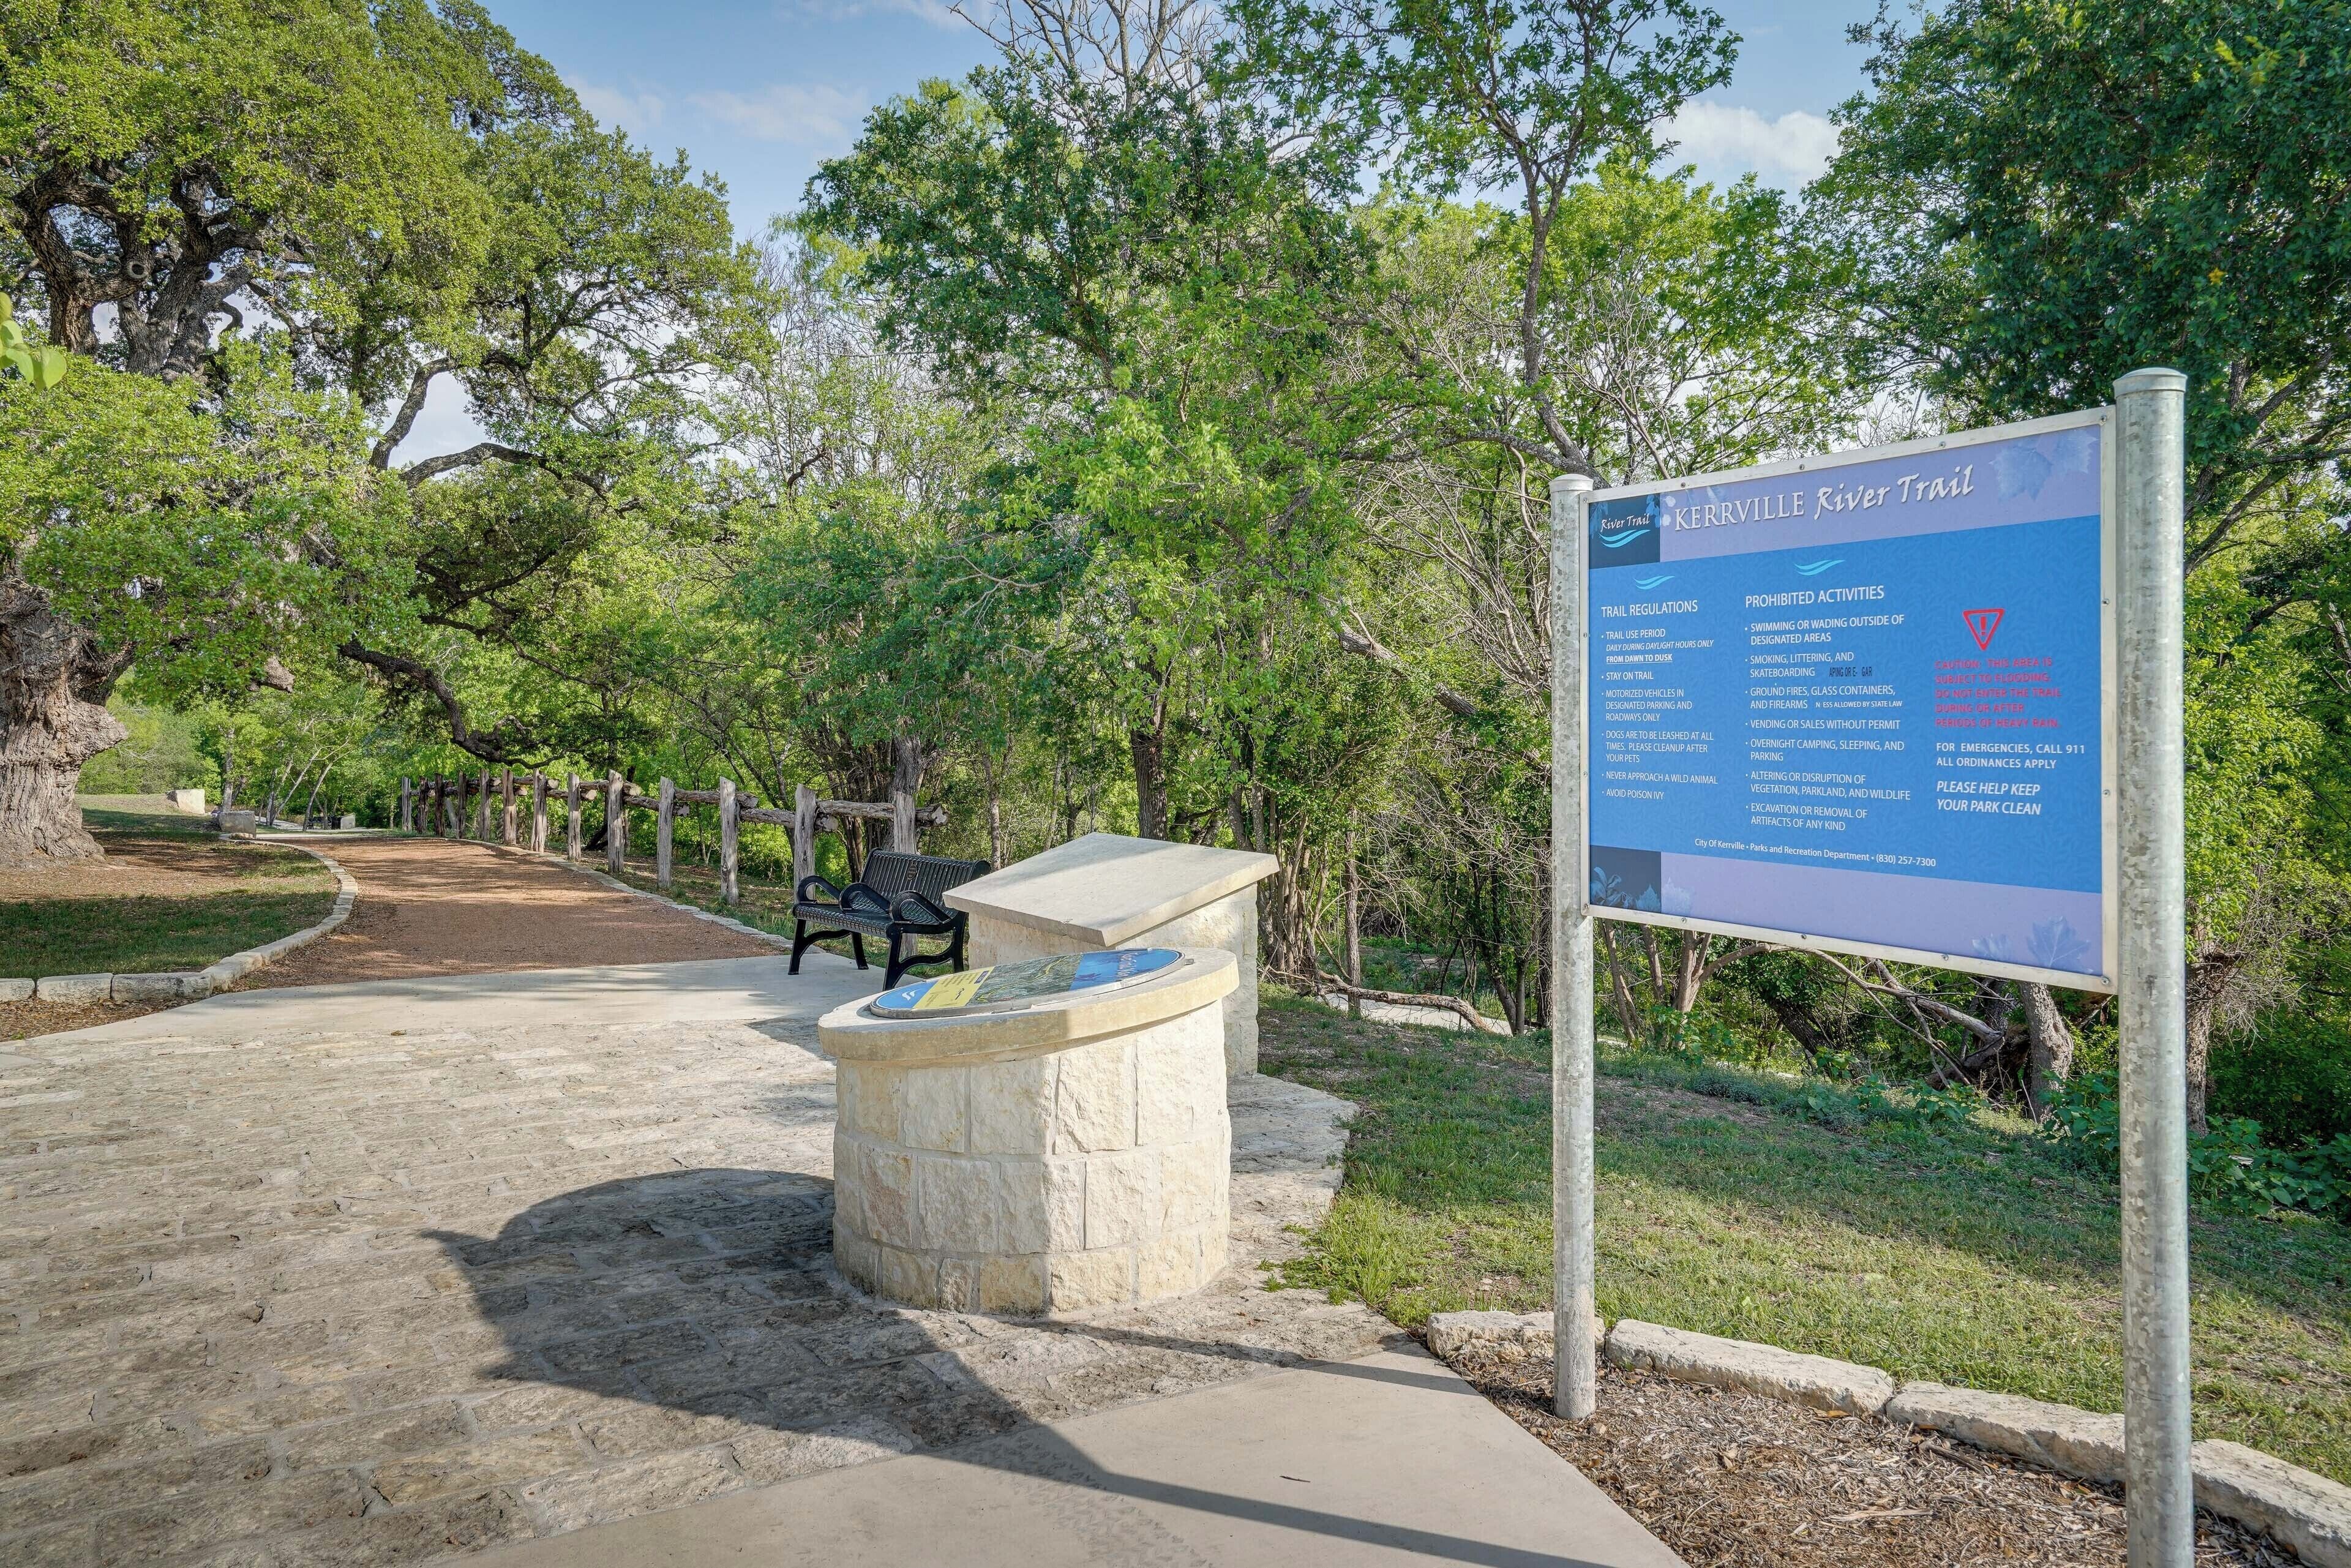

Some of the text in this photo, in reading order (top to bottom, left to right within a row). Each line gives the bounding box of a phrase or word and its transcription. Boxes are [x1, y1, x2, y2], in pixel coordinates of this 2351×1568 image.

[1675, 465, 1973, 530] KERRVILLE River Trail
[1600, 513, 1649, 532] River Trail
[1746, 585, 1884, 607] PROHIBITED ACTIVITIES
[1601, 600, 1697, 617] TRAIL REGULATIONS
[1751, 615, 1904, 632] SWIMMING OR WADING OUTSIDE OF
[1626, 630, 1638, 639] USE
[1641, 629, 1665, 637] PERIOD
[1751, 632, 1831, 645] DESIGNATED AREAS
[1750, 652, 1854, 664] SMOKING, LITTERING, AND
[1635, 671, 1653, 680] TRAIL
[1750, 667, 1815, 677] SKATEBOARDING
[1829, 667, 1844, 677] APING
[1845, 667, 1851, 677] OR
[1750, 685, 1895, 696] GROUND FIRES, GLASS CONTAINERS,
[1801, 720, 1824, 729] SALES
[1826, 720, 1866, 729] WITHOUT
[1869, 720, 1900, 729] PERMIT
[1654, 743, 1684, 752] CLEANUP
[1751, 739, 1904, 751] OVERNIGHT CAMPING, SLEEPING, AND
[1937, 743, 1954, 751] FOR
[1961, 743, 2033, 754] EMERGENCIES,
[2036, 745, 2062, 753] CALL
[1751, 752, 1783, 760] PARKING
[1937, 757, 2056, 768] ALL ORDINANCES APPLY
[1627, 773, 1663, 781] APPROACH
[1671, 774, 1689, 782] WILD
[1690, 775, 1718, 784] ANIMAL
[1751, 771, 1787, 781] ALTERING
[1802, 773, 1851, 783] DISRUPTION
[1854, 775, 1865, 784] OF
[1607, 789, 1626, 797] AVOID
[1627, 790, 1652, 798] POISON
[1751, 784, 1910, 800] VEGETATION, PARKLAND, AND WILDLIFE
[1937, 781, 2040, 795] PLEASE HELP KEEP
[1752, 803, 1798, 814] EXCAVATION
[1814, 807, 1854, 817] REMOVAL
[1856, 809, 1867, 818] OF
[1938, 799, 2041, 814] YOUR PARK CLEAN
[1751, 816, 1845, 830] ARTIFACTS OF ANY KIND
[1695, 839, 1707, 847] City
[1718, 841, 1745, 850] Kerrville
[1750, 843, 1768, 852] Parks
[1784, 846, 1821, 857] Recreation
[1824, 850, 1869, 861] Department
[1876, 854, 1895, 864] (830)
[1897, 856, 1936, 866] 257-7300
